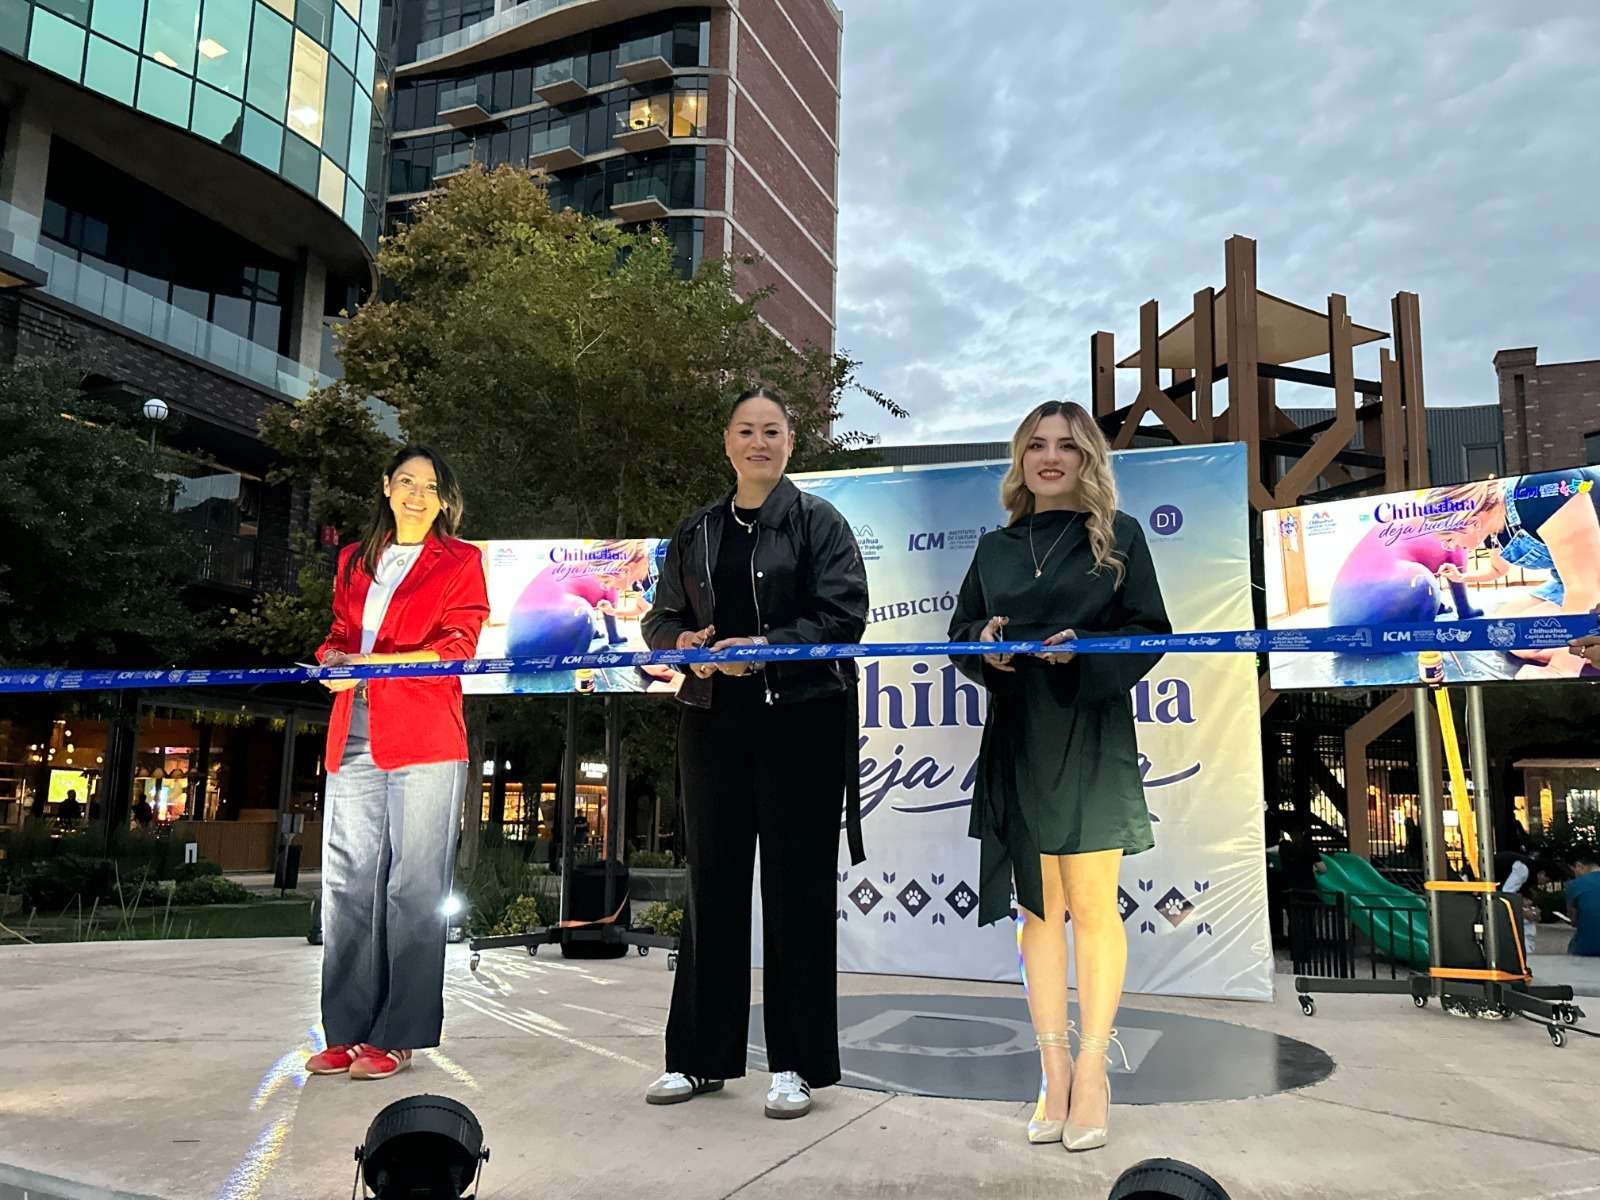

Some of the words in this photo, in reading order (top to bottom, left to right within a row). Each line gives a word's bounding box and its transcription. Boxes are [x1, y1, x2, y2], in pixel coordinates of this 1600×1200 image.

[1157, 512, 1176, 527] D1
[908, 532, 945, 552] ICM
[1379, 522, 1416, 547] deja
[866, 591, 958, 624] HIBICIÓ
[1140, 639, 1166, 647] ICM
[1383, 631, 1411, 641] ICM
[561, 655, 583, 664] ICM
